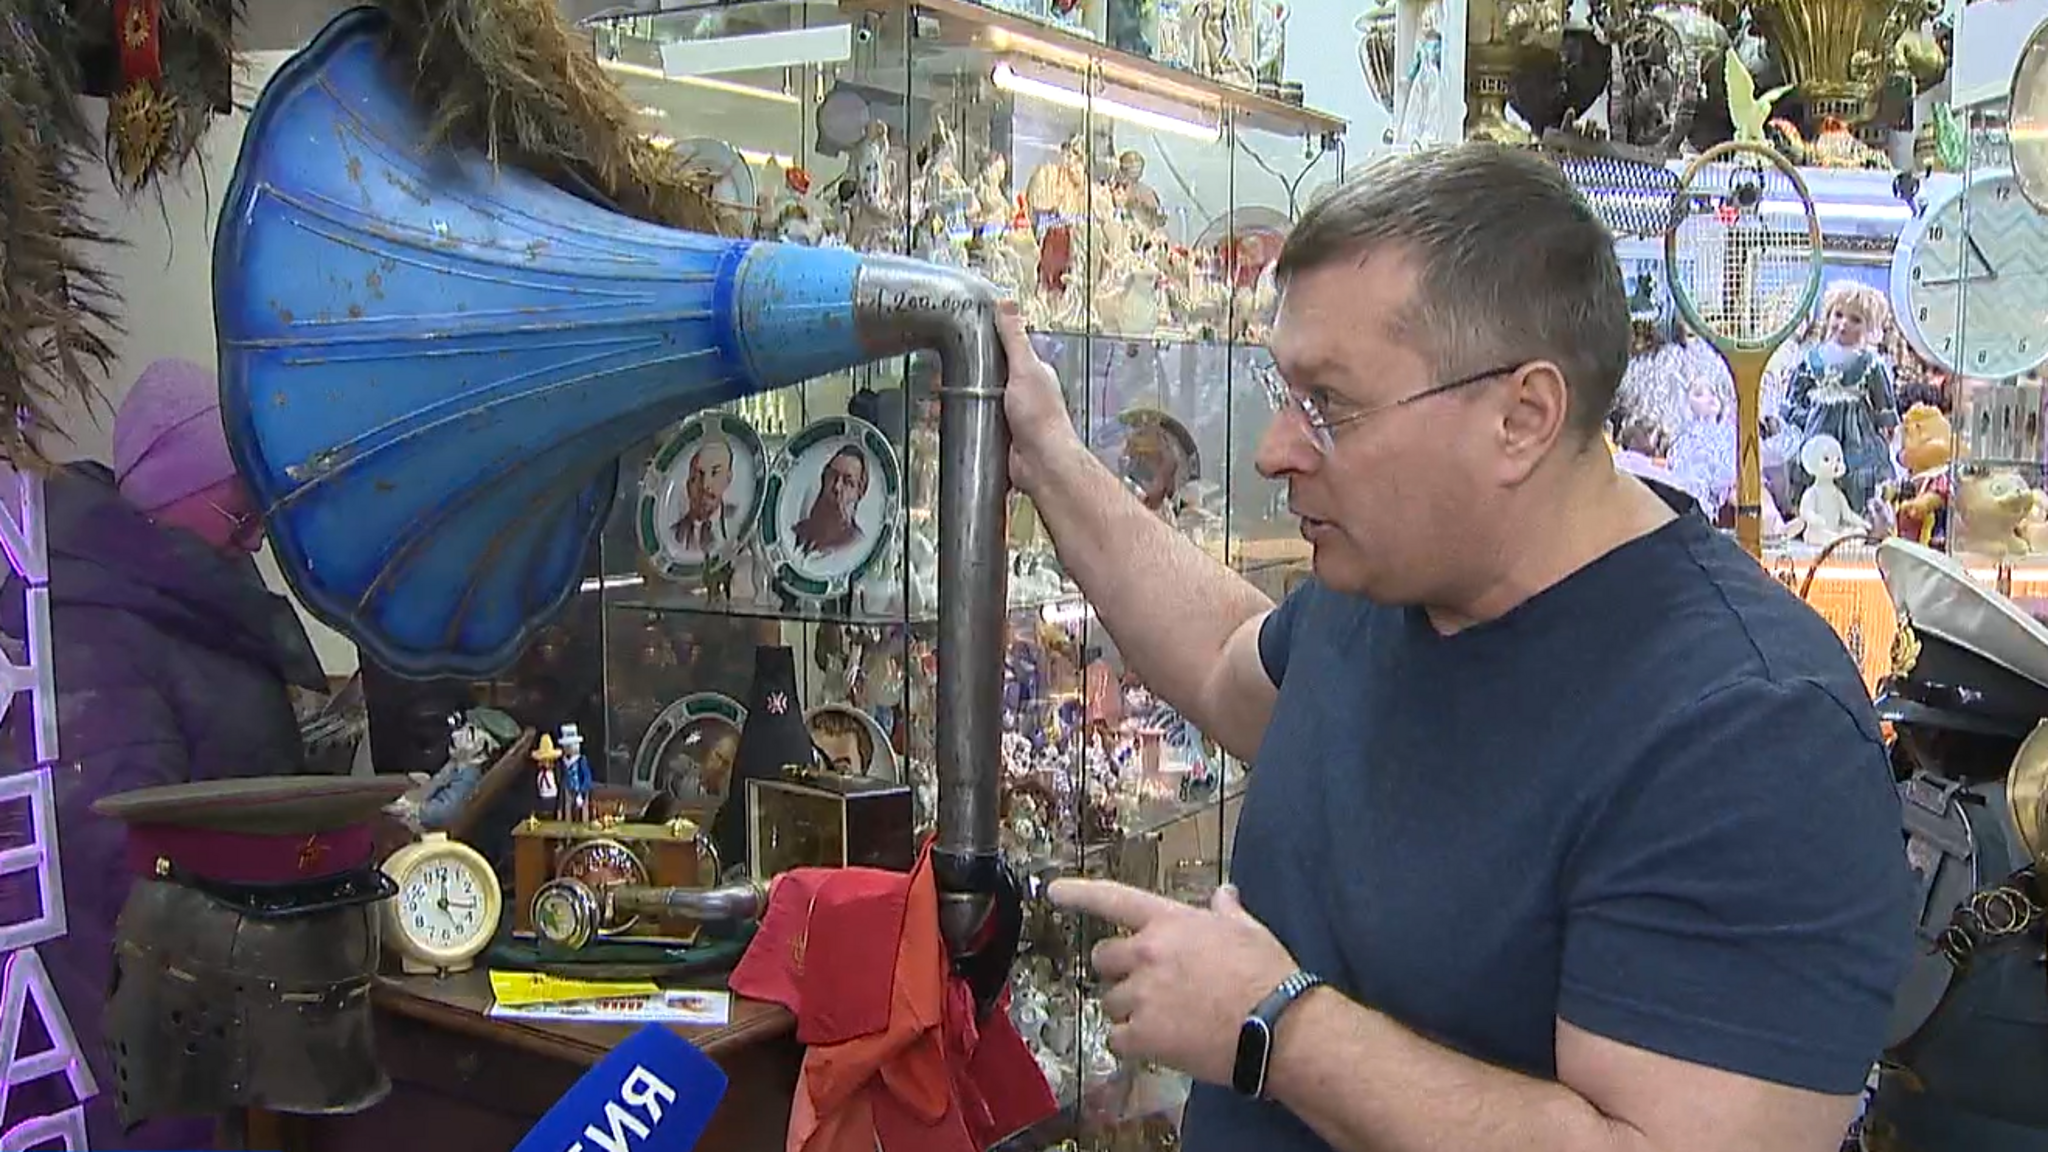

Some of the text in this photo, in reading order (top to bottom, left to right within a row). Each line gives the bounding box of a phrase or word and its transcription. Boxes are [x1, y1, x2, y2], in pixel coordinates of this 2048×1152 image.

[1929, 226, 1943, 242] 10
[1912, 267, 1921, 281] 9
[566, 1064, 676, 1152] ИЯ
